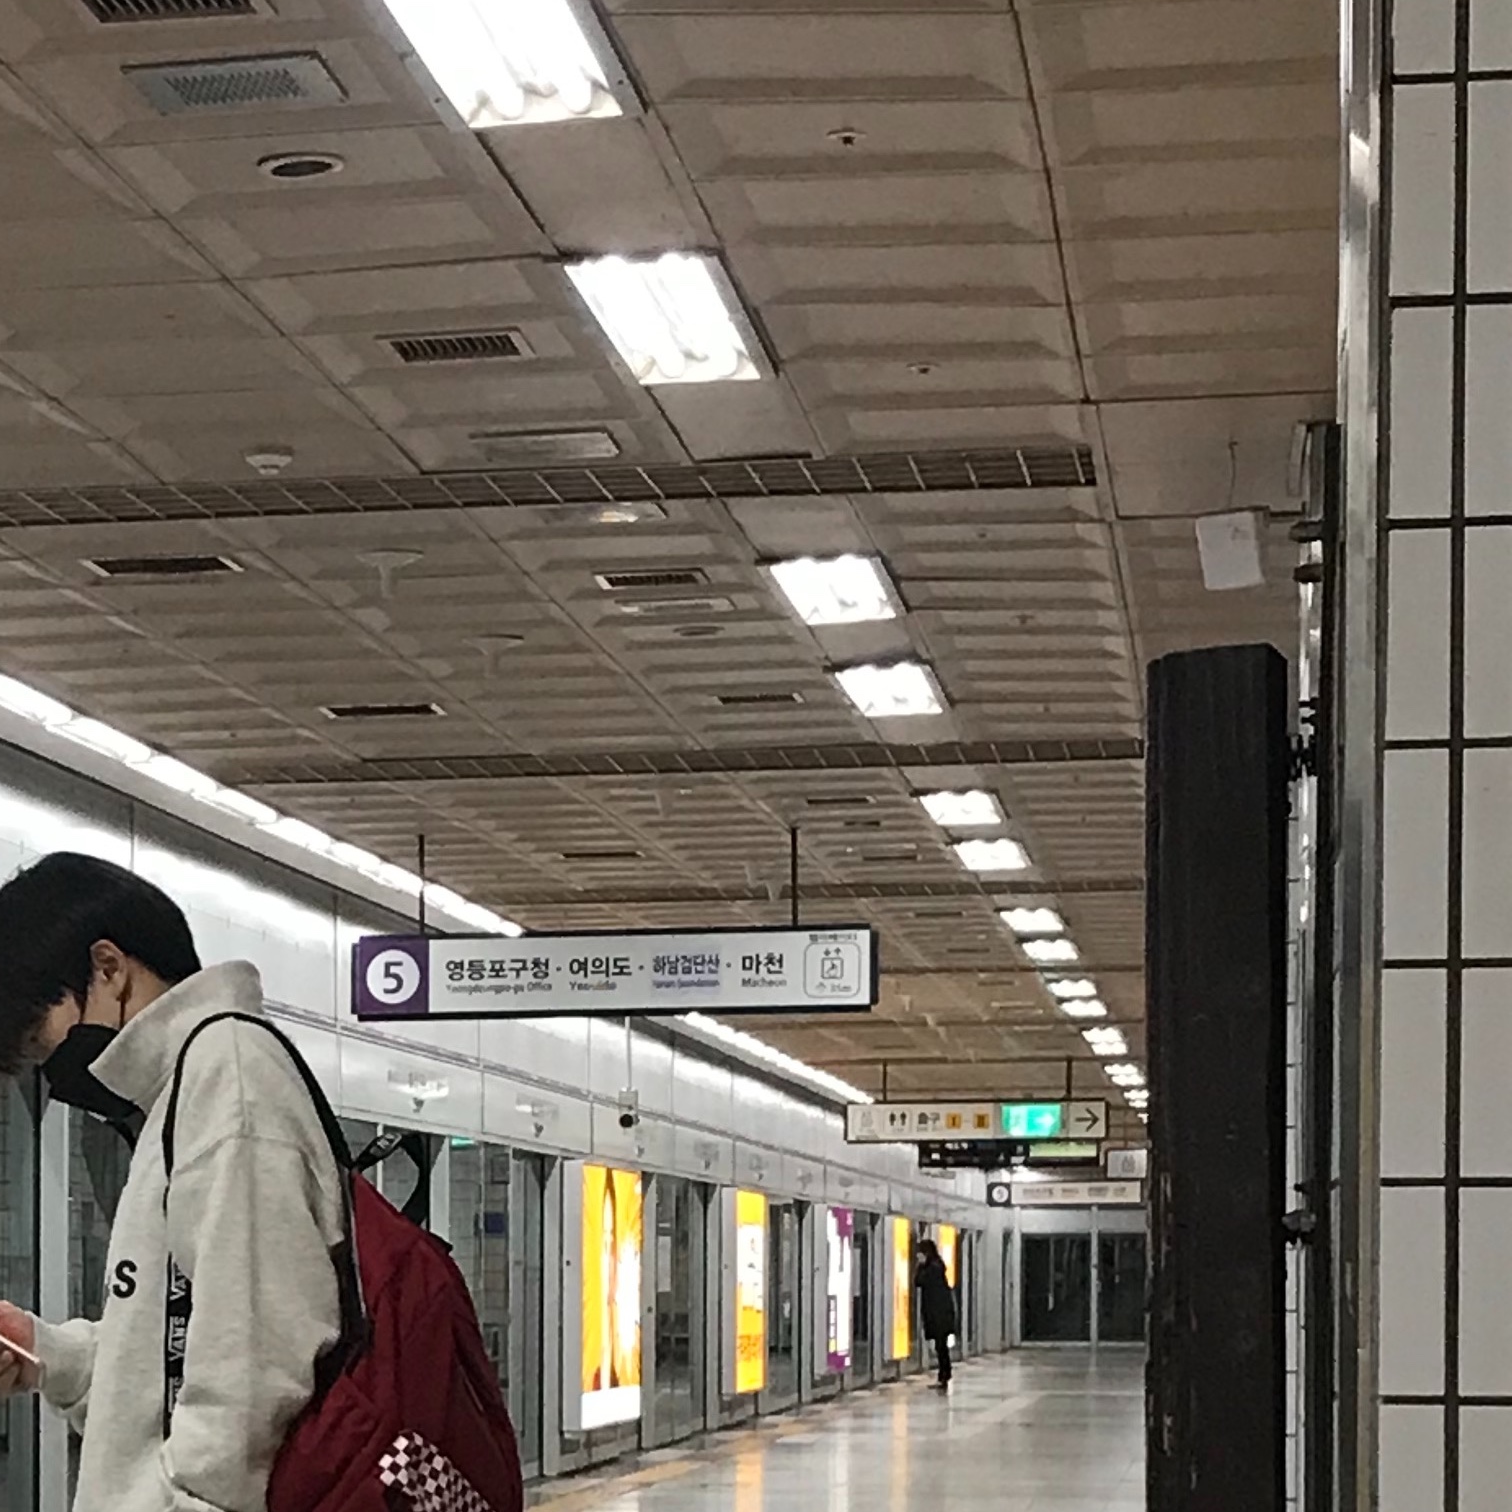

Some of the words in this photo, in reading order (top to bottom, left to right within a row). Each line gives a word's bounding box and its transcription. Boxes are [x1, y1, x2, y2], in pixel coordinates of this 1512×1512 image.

[382, 961, 405, 995] 5
[445, 958, 550, 981] 영등포구청
[569, 956, 632, 978] 여의도
[652, 954, 720, 975] 하남검단산
[741, 952, 784, 975] 마천
[168, 1315, 187, 1362] VANS
